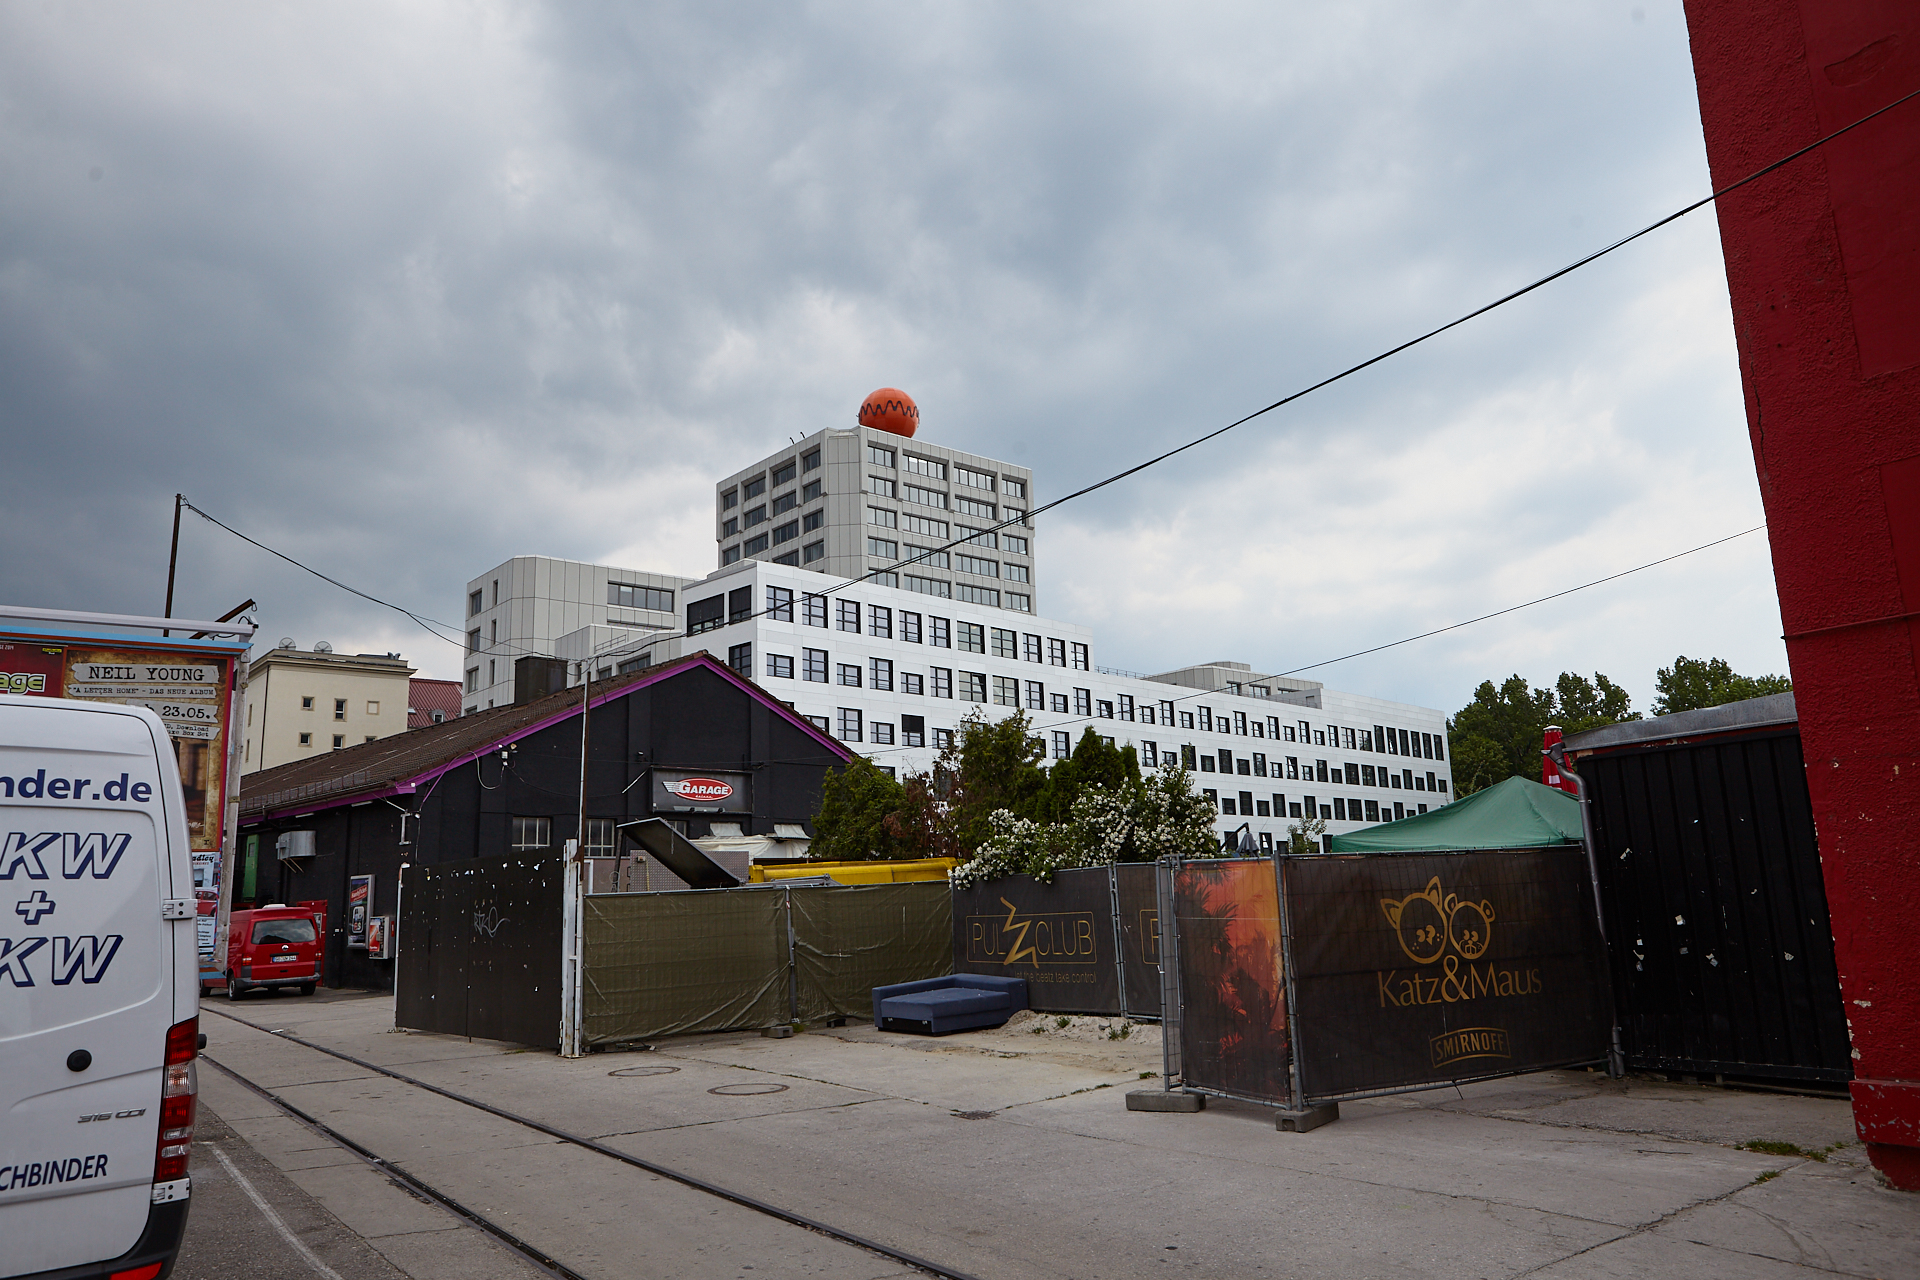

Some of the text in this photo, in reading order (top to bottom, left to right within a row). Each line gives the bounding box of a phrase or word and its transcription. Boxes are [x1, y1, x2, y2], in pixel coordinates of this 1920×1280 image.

[89, 666, 205, 681] NEIL YOUNG
[162, 705, 210, 719] 23.05.
[680, 781, 729, 795] GARAGE
[1024, 971, 1034, 982] the
[1056, 972, 1070, 983] take
[1072, 971, 1097, 984] control
[1436, 1032, 1504, 1061] SMIRNOFF
[77, 1107, 147, 1124] 316 CDI
[0, 1153, 109, 1192] CHBINDER
